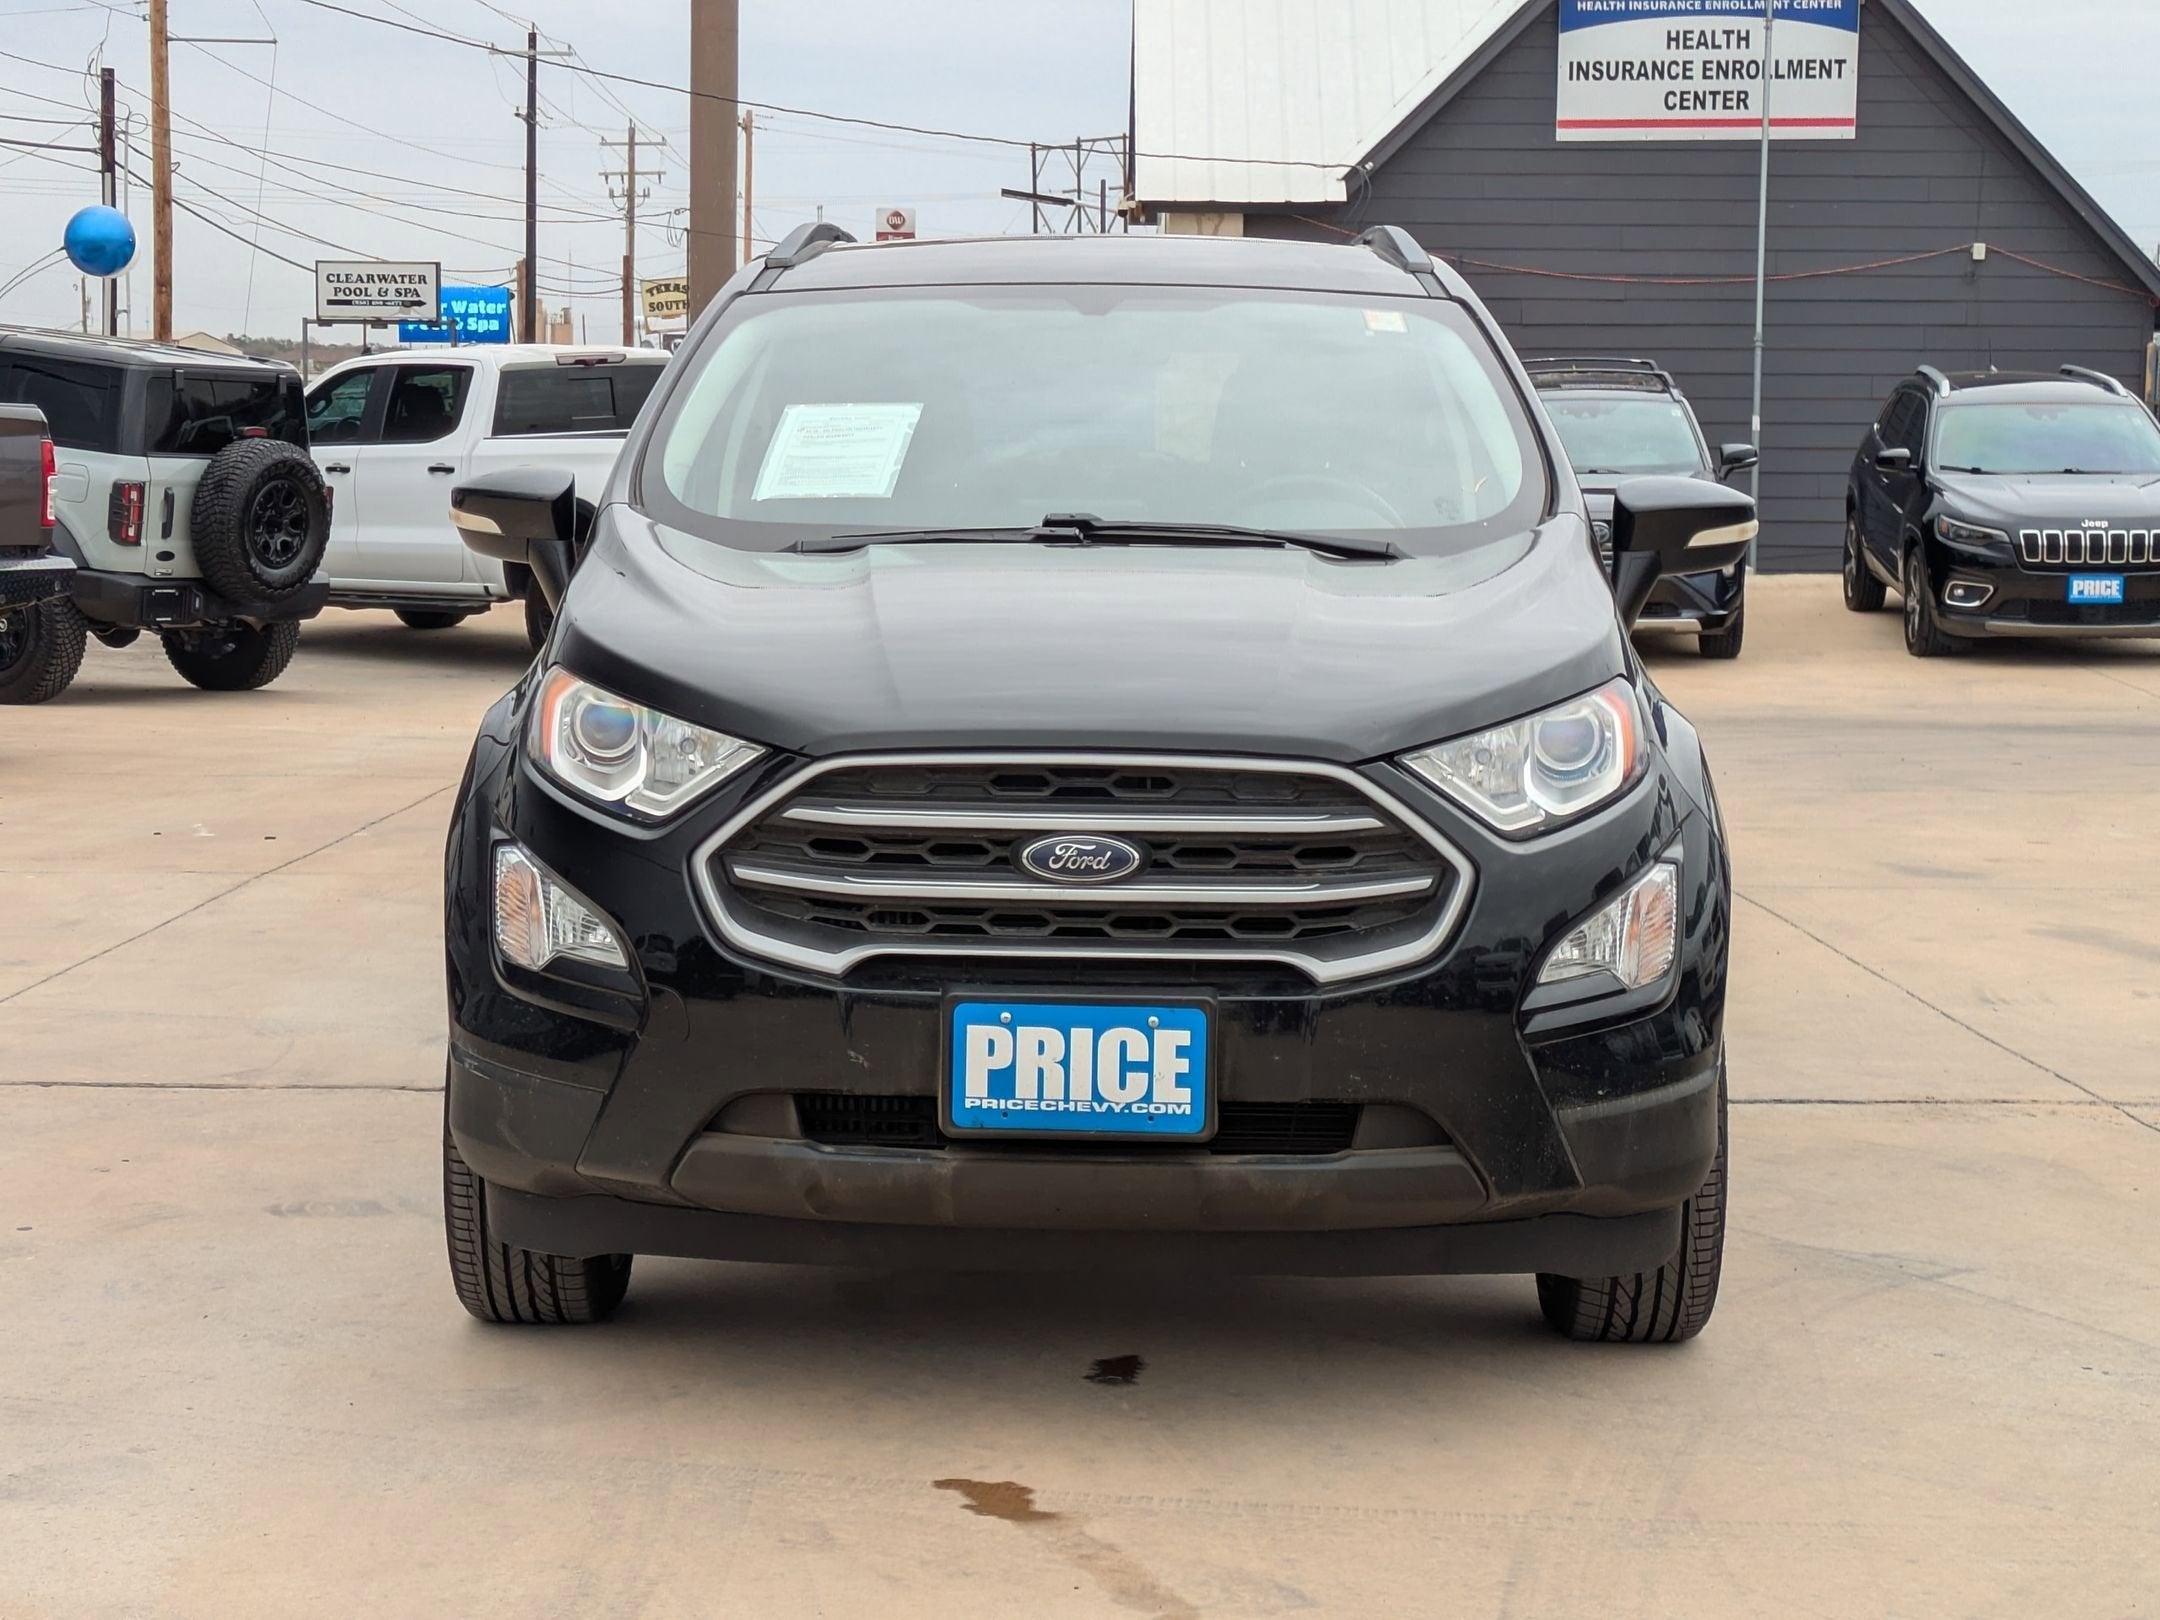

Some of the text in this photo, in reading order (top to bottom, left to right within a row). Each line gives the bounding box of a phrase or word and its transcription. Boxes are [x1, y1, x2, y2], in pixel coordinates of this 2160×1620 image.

[1577, 0, 1842, 11] HEALTH INSURANCE ENROLLMNT CENTER
[1666, 29, 1750, 50] HEALTH
[1568, 60, 1694, 81] INSURANCE
[1663, 90, 1750, 110] CENTER
[325, 273, 428, 285] CLEARWATER
[333, 286, 421, 298] POOL & SPA
[451, 300, 507, 314] Water
[466, 317, 500, 333] Spa
[2081, 519, 2109, 529] Jeep
[2072, 579, 2121, 596] PRICE
[1048, 843, 1113, 870] Ford
[965, 1024, 1192, 1104] PRICE
[964, 1097, 1192, 1115] PRICECHEVY.COM
